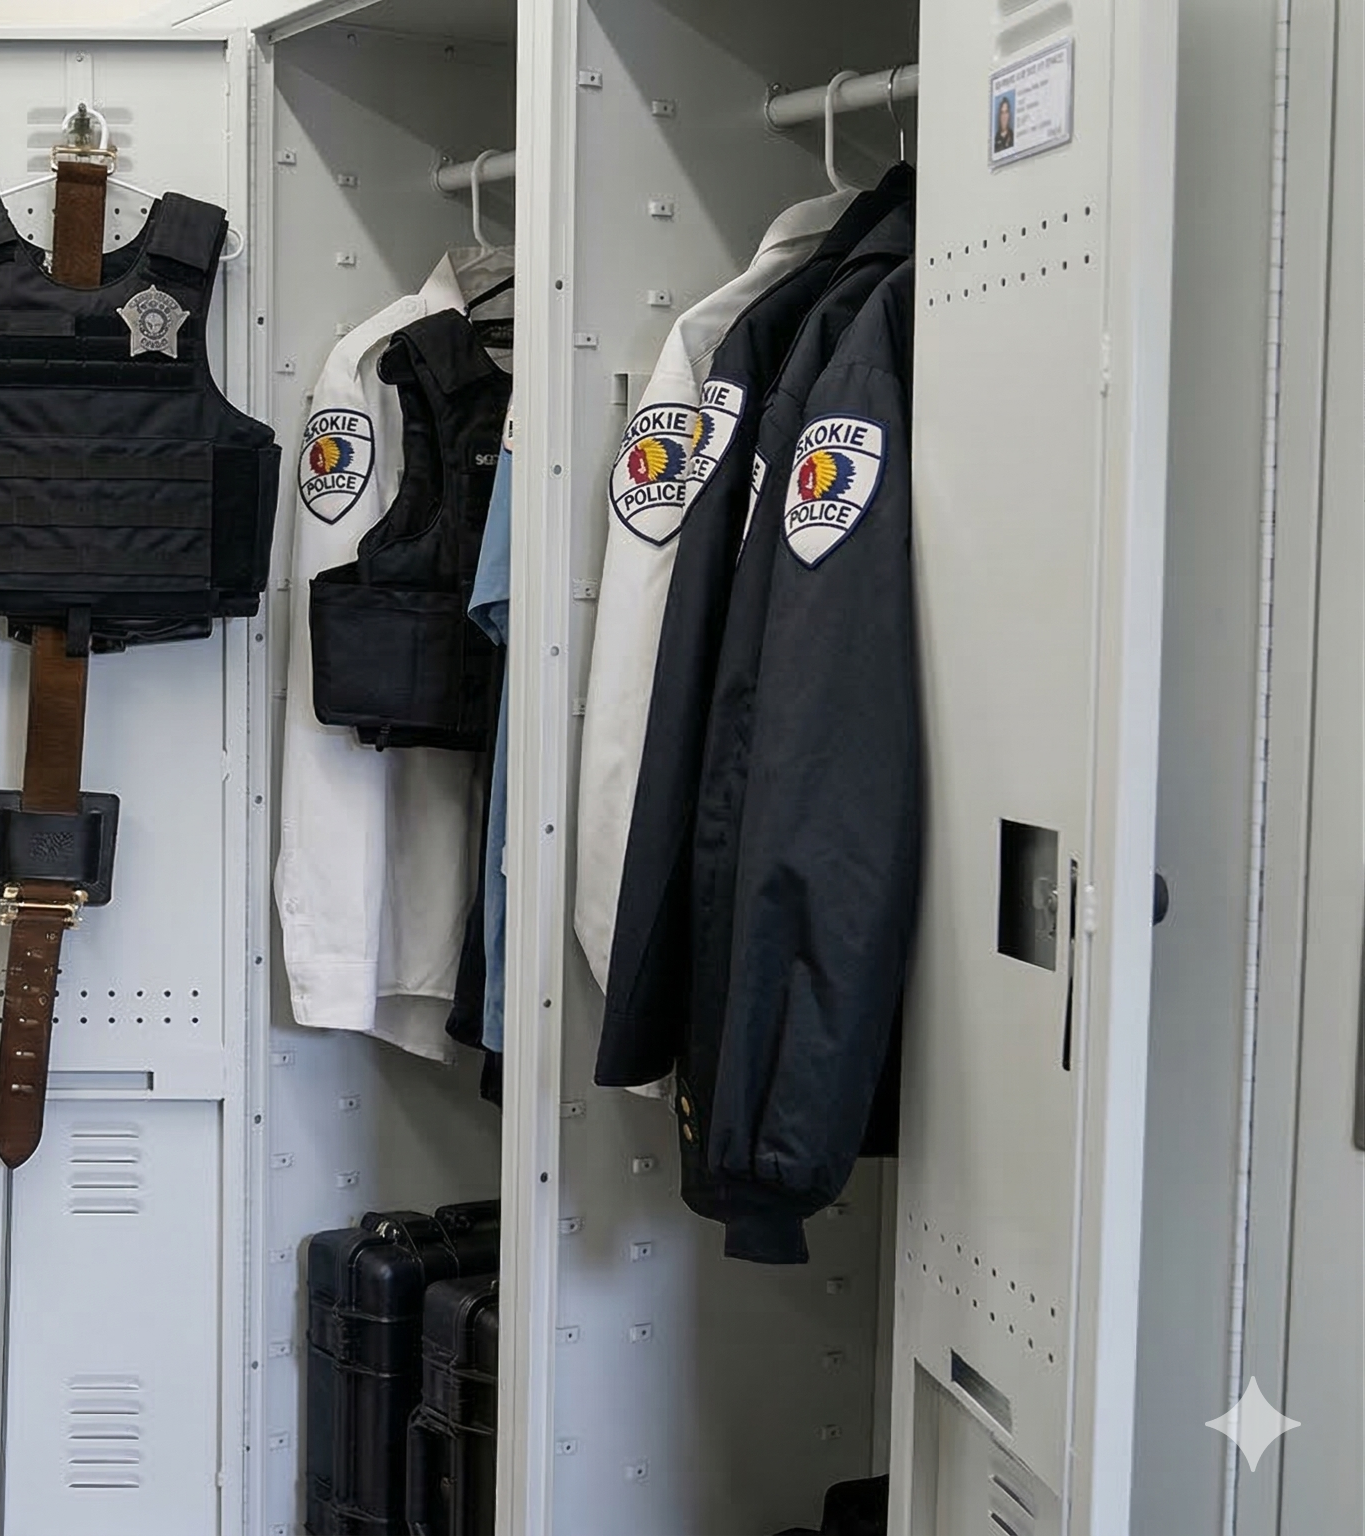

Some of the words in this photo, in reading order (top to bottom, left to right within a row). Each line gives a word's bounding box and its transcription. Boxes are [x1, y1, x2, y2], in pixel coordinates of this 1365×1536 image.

[796, 423, 868, 459] SKOKIE
[307, 474, 357, 496] POLICE
[624, 484, 686, 511] POLICE
[789, 503, 852, 529] POLICE
